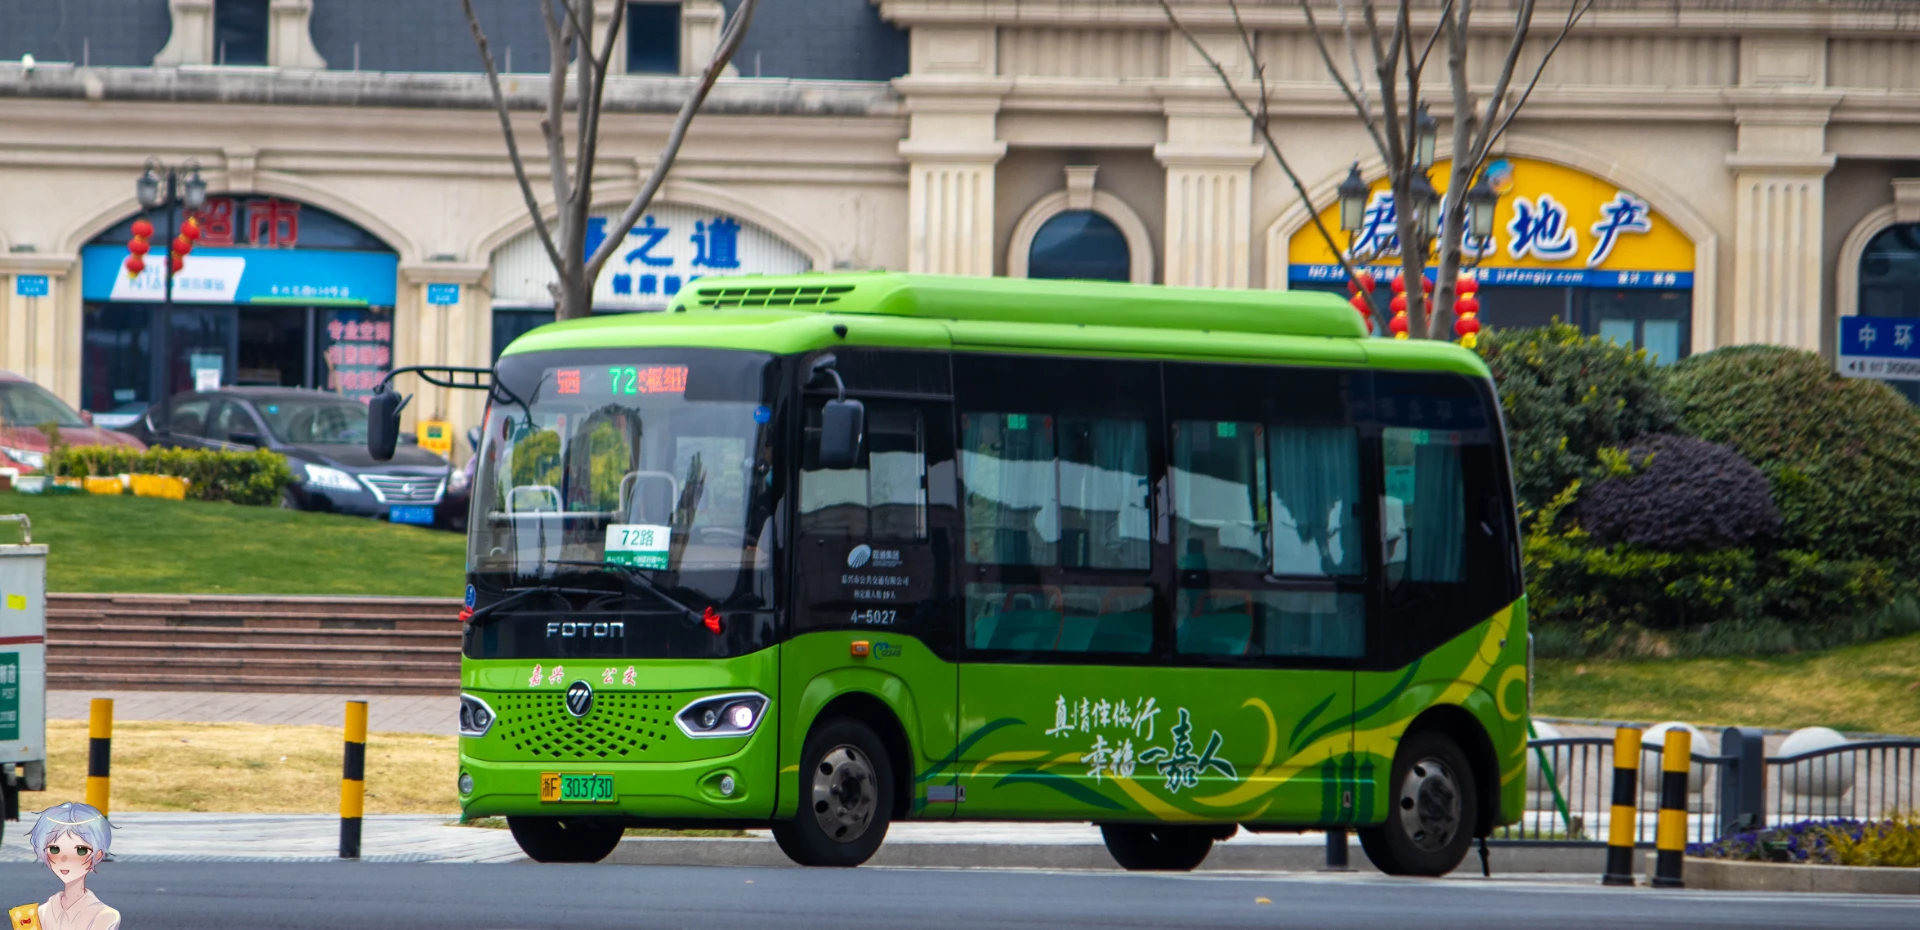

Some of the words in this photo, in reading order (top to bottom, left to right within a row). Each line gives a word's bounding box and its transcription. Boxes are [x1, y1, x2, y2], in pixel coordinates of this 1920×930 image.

[183, 197, 301, 249] 超市
[608, 366, 638, 395] 72
[622, 529, 655, 547] 72路
[850, 609, 897, 625] 4-5027
[546, 622, 625, 638] FOTON
[601, 665, 638, 687] 公交
[1044, 694, 1162, 741] 真情伴你行
